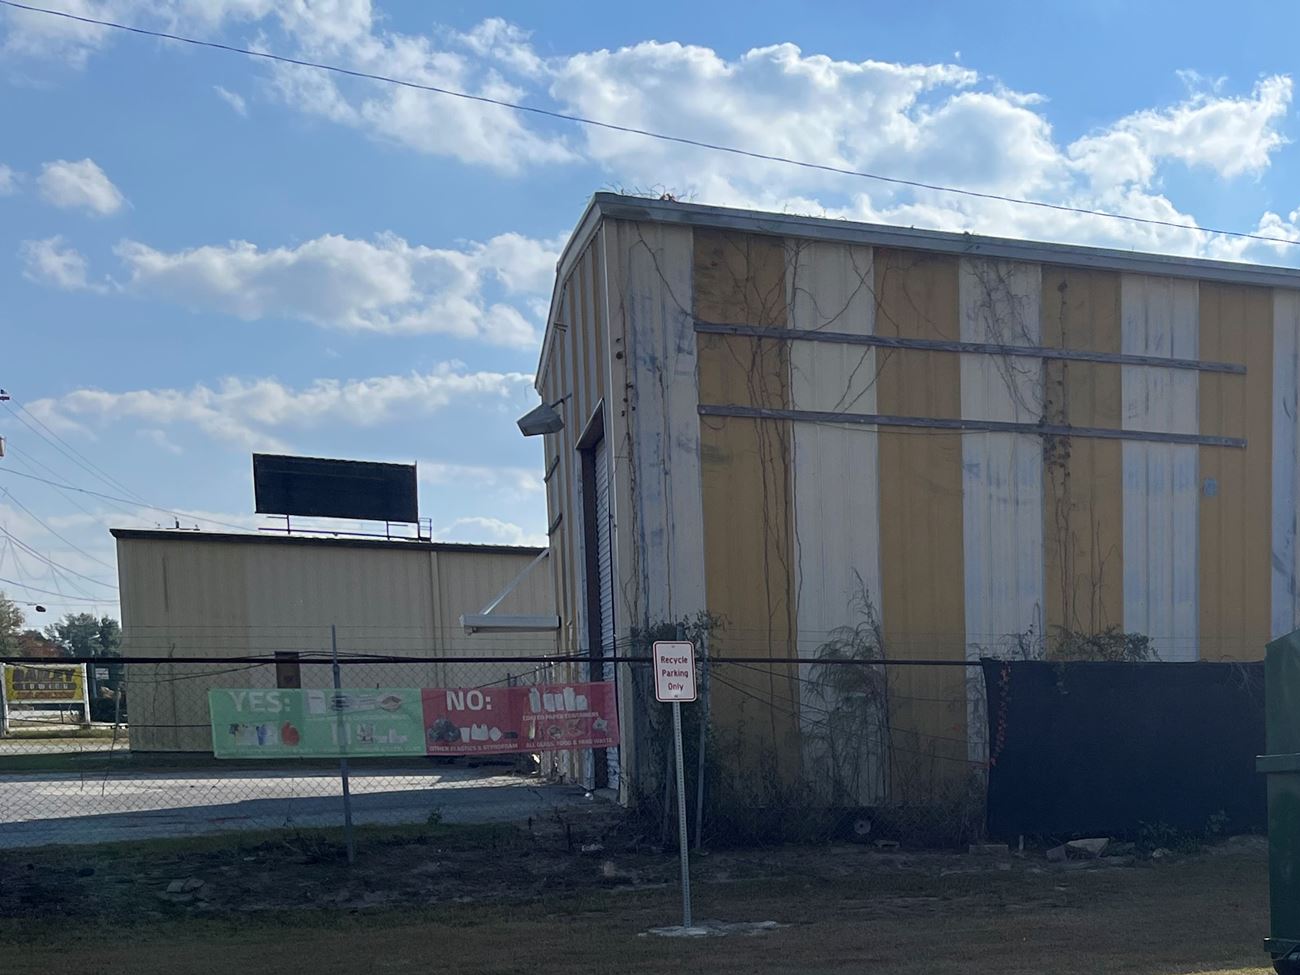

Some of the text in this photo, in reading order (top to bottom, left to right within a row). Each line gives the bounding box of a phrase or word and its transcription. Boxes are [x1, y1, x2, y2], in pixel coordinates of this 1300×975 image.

[660, 656, 688, 665] Recycle
[661, 669, 689, 678] Parking
[667, 682, 684, 691] Only
[229, 691, 291, 712] YES:
[446, 690, 492, 711] NO:
